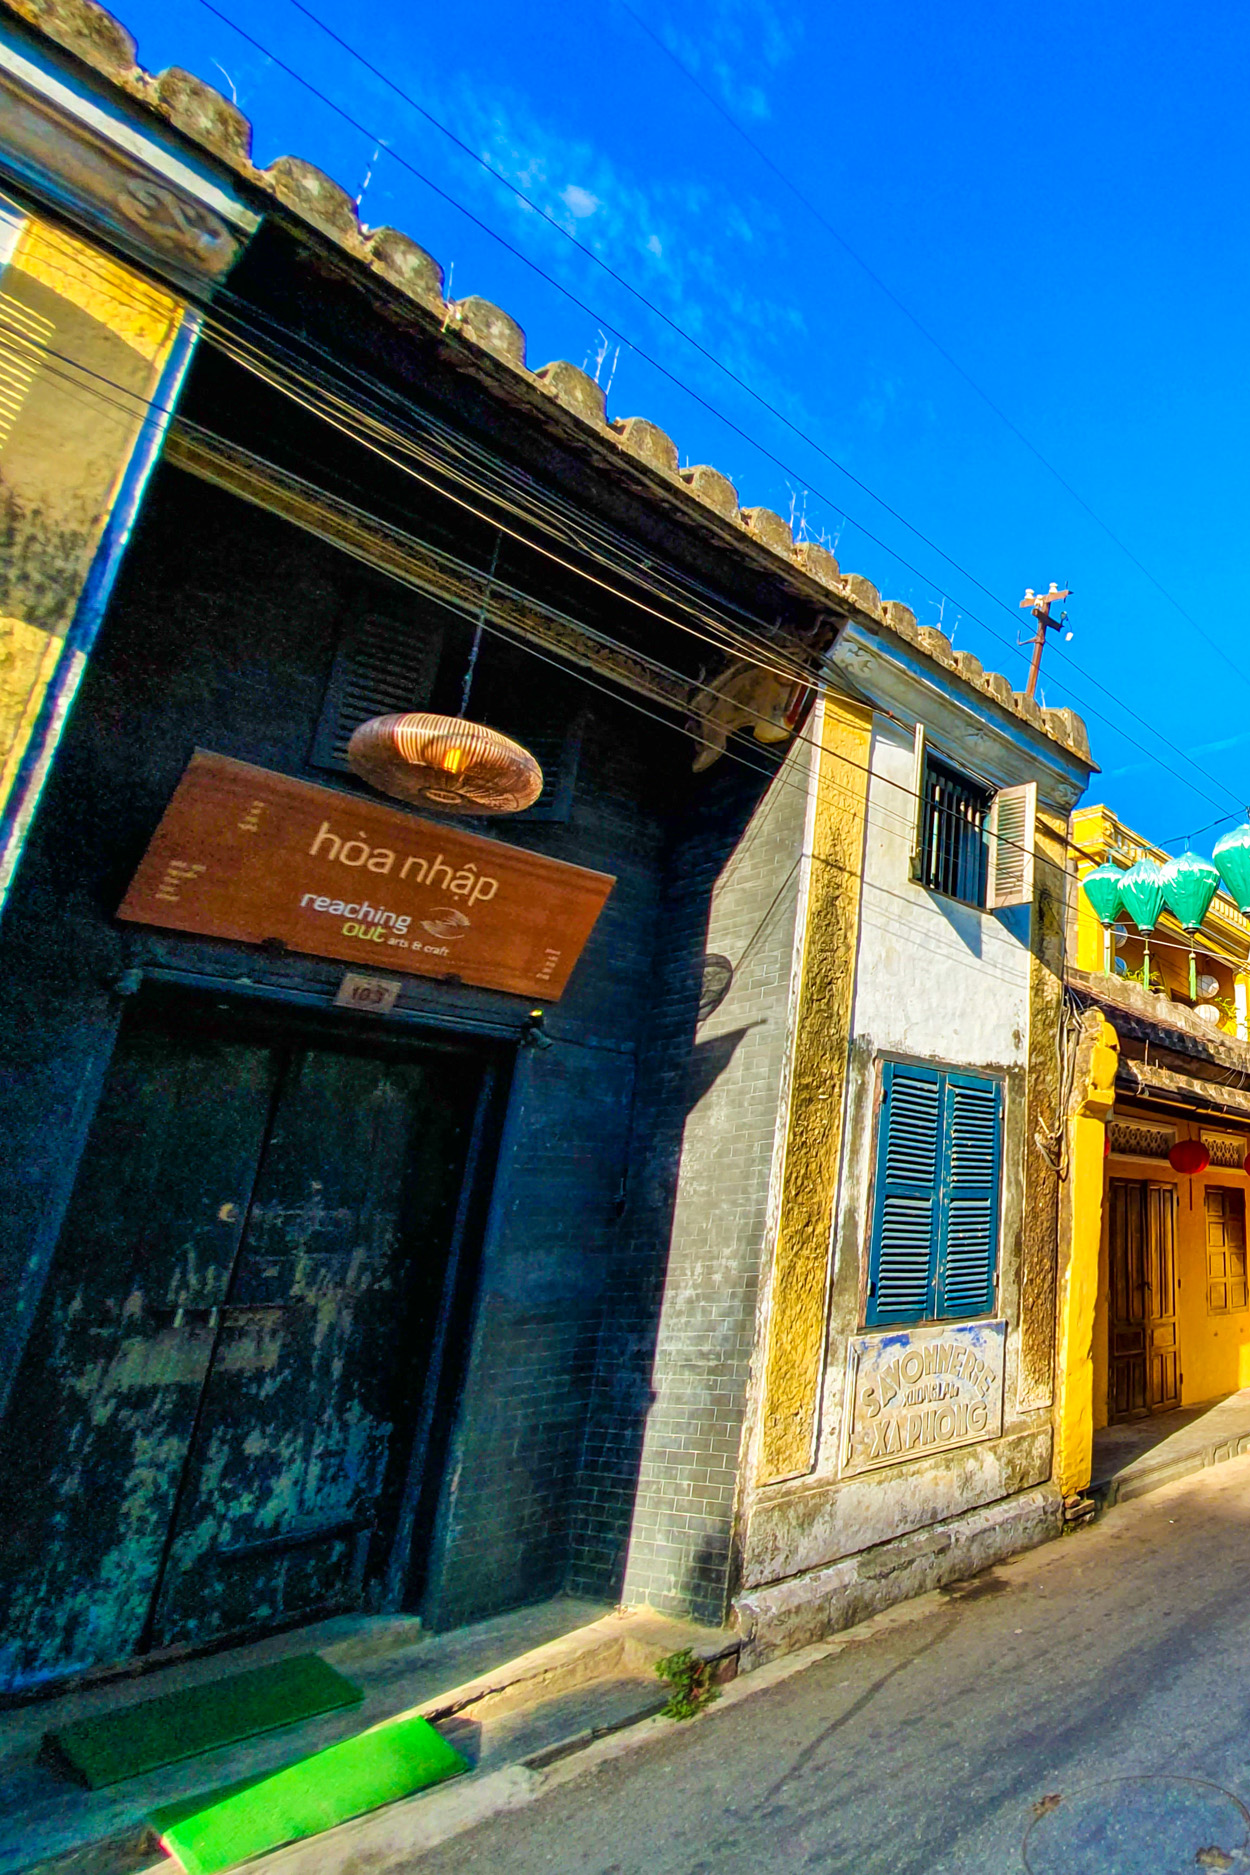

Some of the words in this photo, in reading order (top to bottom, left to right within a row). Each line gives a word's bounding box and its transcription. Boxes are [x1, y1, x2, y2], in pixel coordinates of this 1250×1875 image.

[309, 821, 396, 874] hòa
[400, 854, 499, 907] nhập
[300, 892, 412, 935] reaching
[341, 921, 387, 942] out
[387, 937, 409, 949] arts
[411, 941, 423, 951] &
[423, 945, 450, 957] craft
[871, 1419, 902, 1458] XA
[906, 1400, 989, 1449] PHONG
